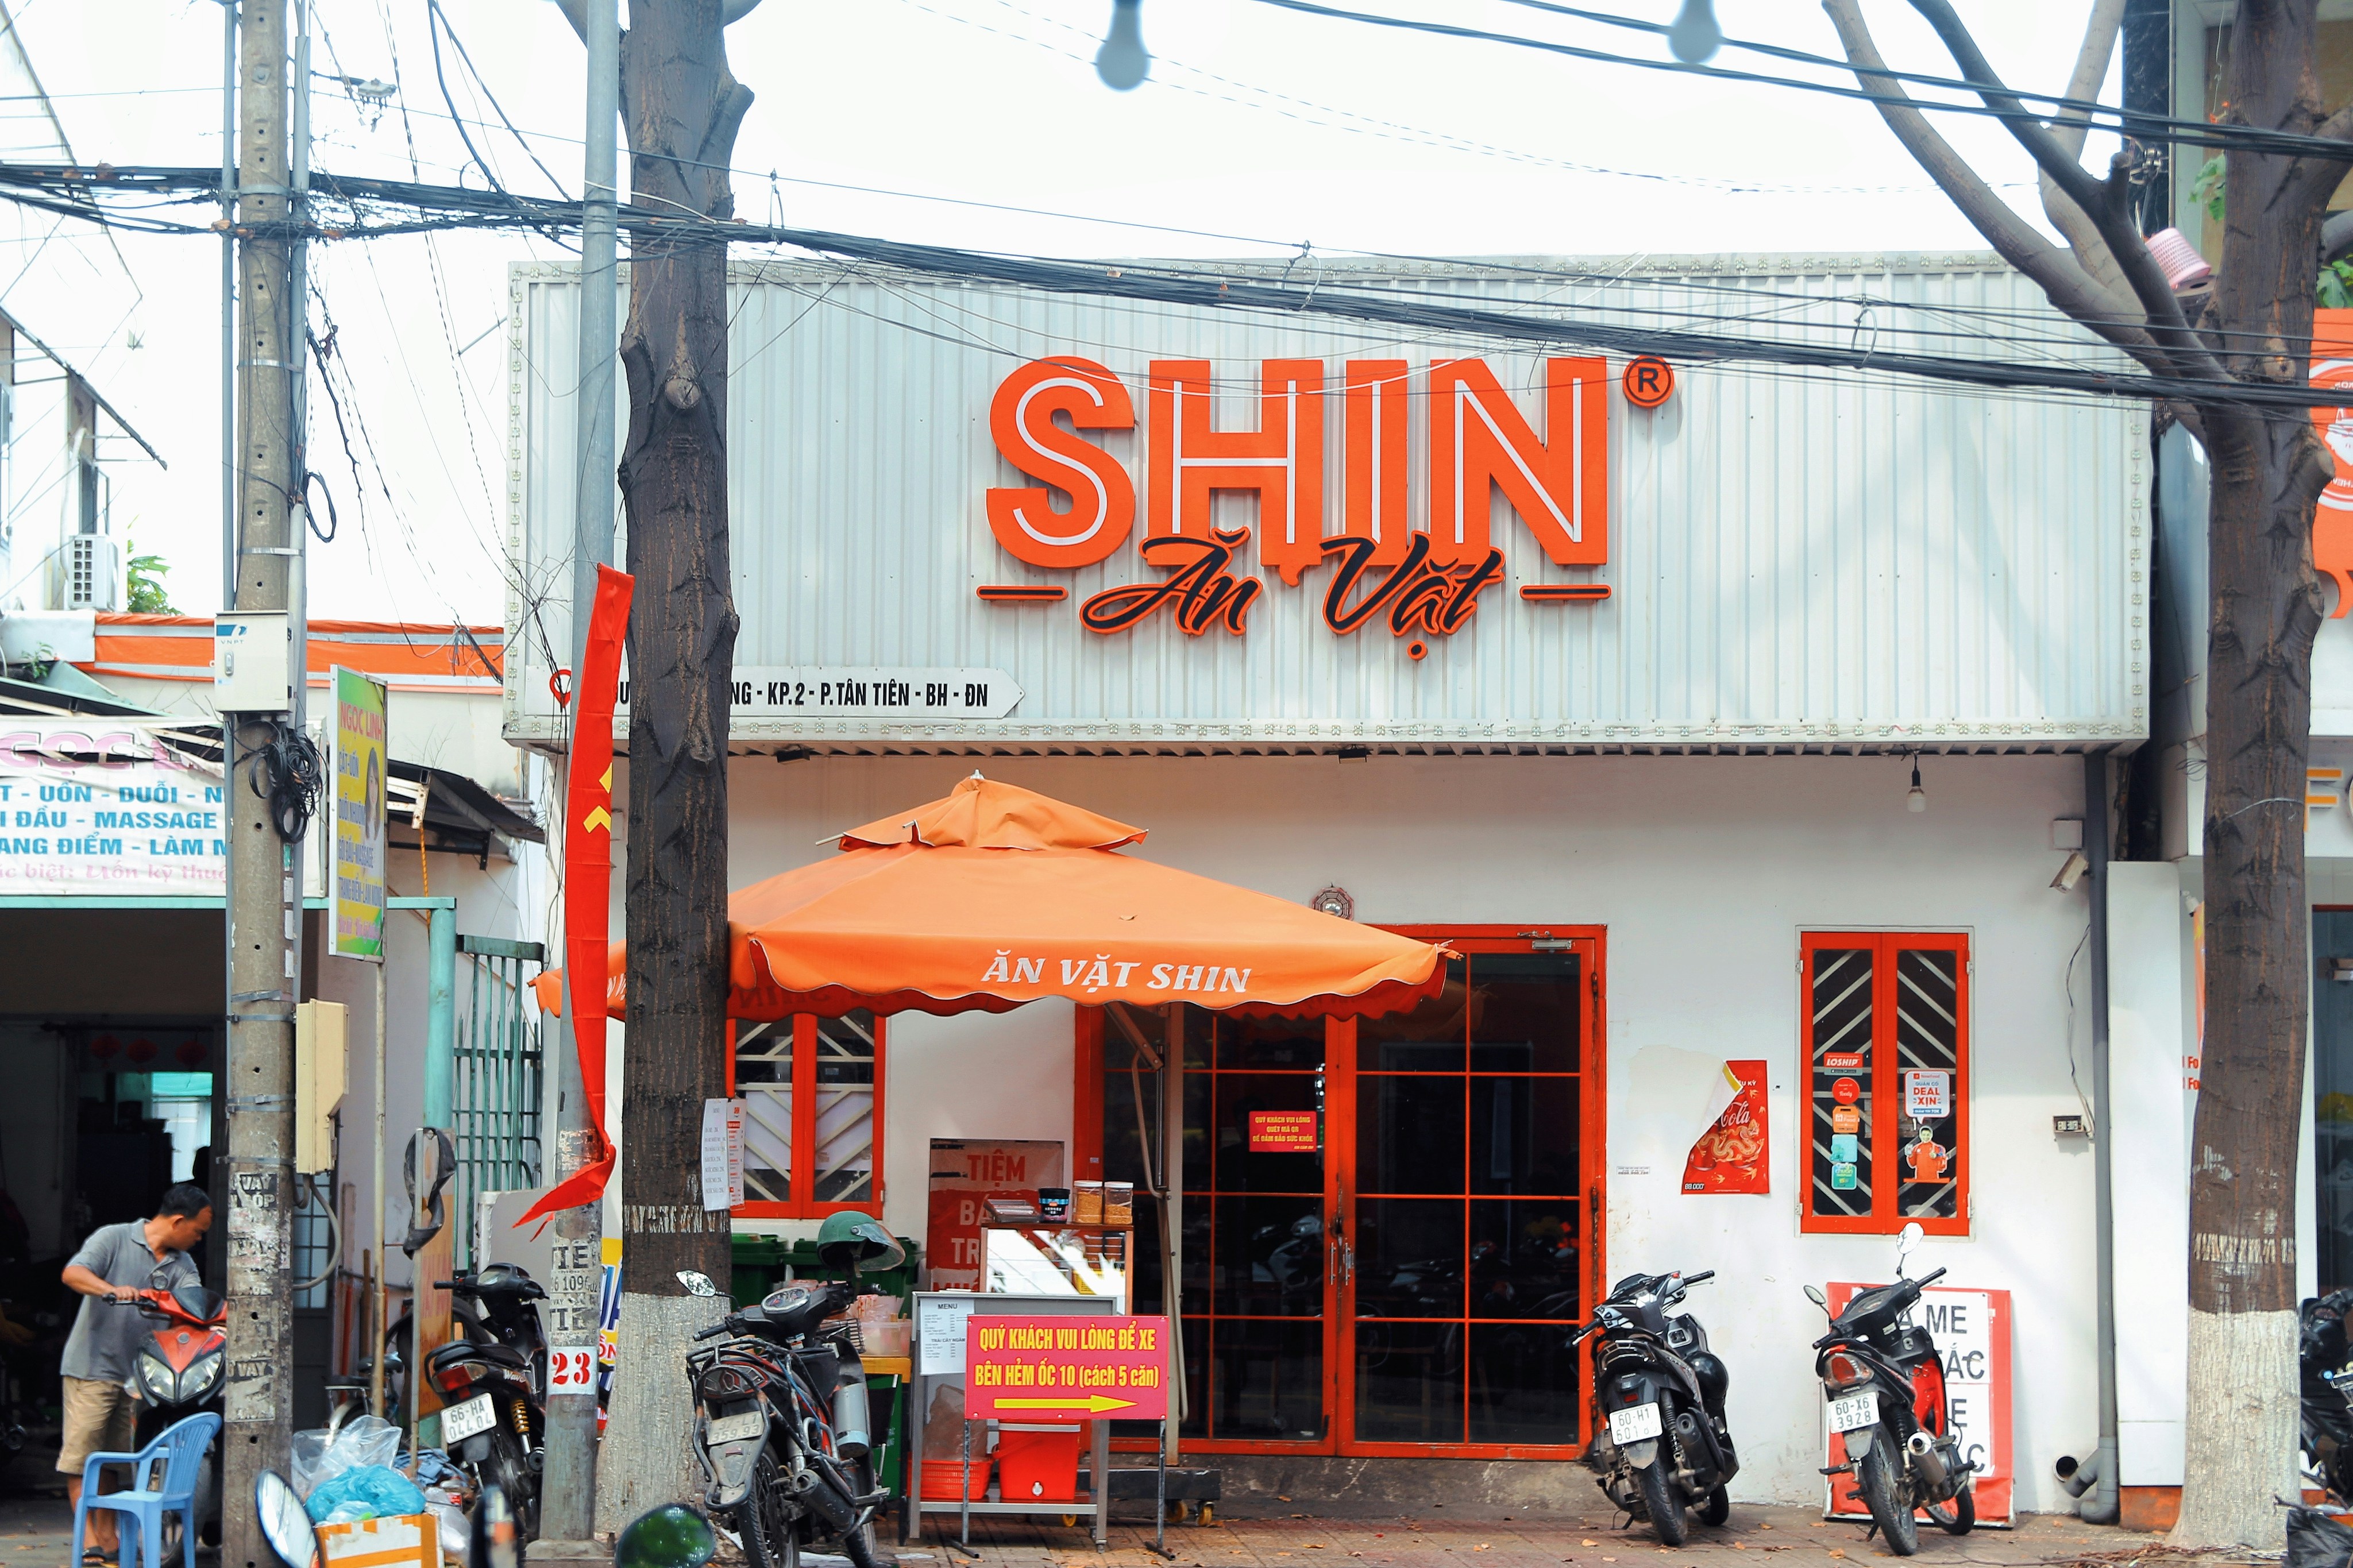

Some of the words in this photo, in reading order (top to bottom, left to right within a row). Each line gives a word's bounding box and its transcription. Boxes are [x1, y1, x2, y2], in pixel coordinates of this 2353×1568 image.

[986, 356, 1607, 569] SHIN
[1080, 527, 1263, 635] Ăn
[1320, 530, 1505, 661] Vặt
[873, 679, 910, 707] TIÊN
[925, 683, 948, 707] BH
[965, 683, 988, 707] ĐN
[366, 710, 383, 742] LINH
[0, 732, 136, 776] GỌC
[16, 805, 67, 828] ĐẦU
[94, 812, 217, 829] MASSAGE
[0, 838, 48, 855] ANG
[57, 831, 122, 855] ĐIỂM
[150, 835, 203, 855] LÀM
[148, 863, 172, 882] kỹ
[981, 949, 1046, 983] ĂN
[1060, 953, 1142, 993] VẶT
[1147, 963, 1252, 993] SHIN
[1826, 1058, 1859, 1067] LOSHIP
[1914, 1087, 1940, 1096] DEAL
[1917, 1096, 1937, 1107] XỊN
[967, 1149, 1026, 1187] TIỆM
[241, 1176, 272, 1191] VAY
[951, 1237, 980, 1264] TR
[1926, 1304, 1967, 1334] ME
[979, 1323, 1005, 1351] QUÝ
[1009, 1324, 1054, 1350] KHÁCH
[1056, 1328, 1078, 1350] VUI
[1081, 1323, 1116, 1350] LÒNG
[1118, 1320, 1137, 1350] ĐỂ
[1139, 1328, 1156, 1350] XE
[552, 1352, 591, 1385] 23
[975, 1360, 1002, 1386] BÊN
[1005, 1357, 1035, 1386] HẺM
[1037, 1357, 1056, 1386] ỐC
[1059, 1365, 1075, 1387] 10
[1079, 1364, 1116, 1389] (cách
[1118, 1365, 1128, 1387] 5
[1130, 1364, 1159, 1389] căn)
[450, 1400, 485, 1423] 66-HA
[1618, 1408, 1650, 1427] 60-H1
[1835, 1397, 1869, 1415] 60-X6
[1837, 1410, 1871, 1429] 3928
